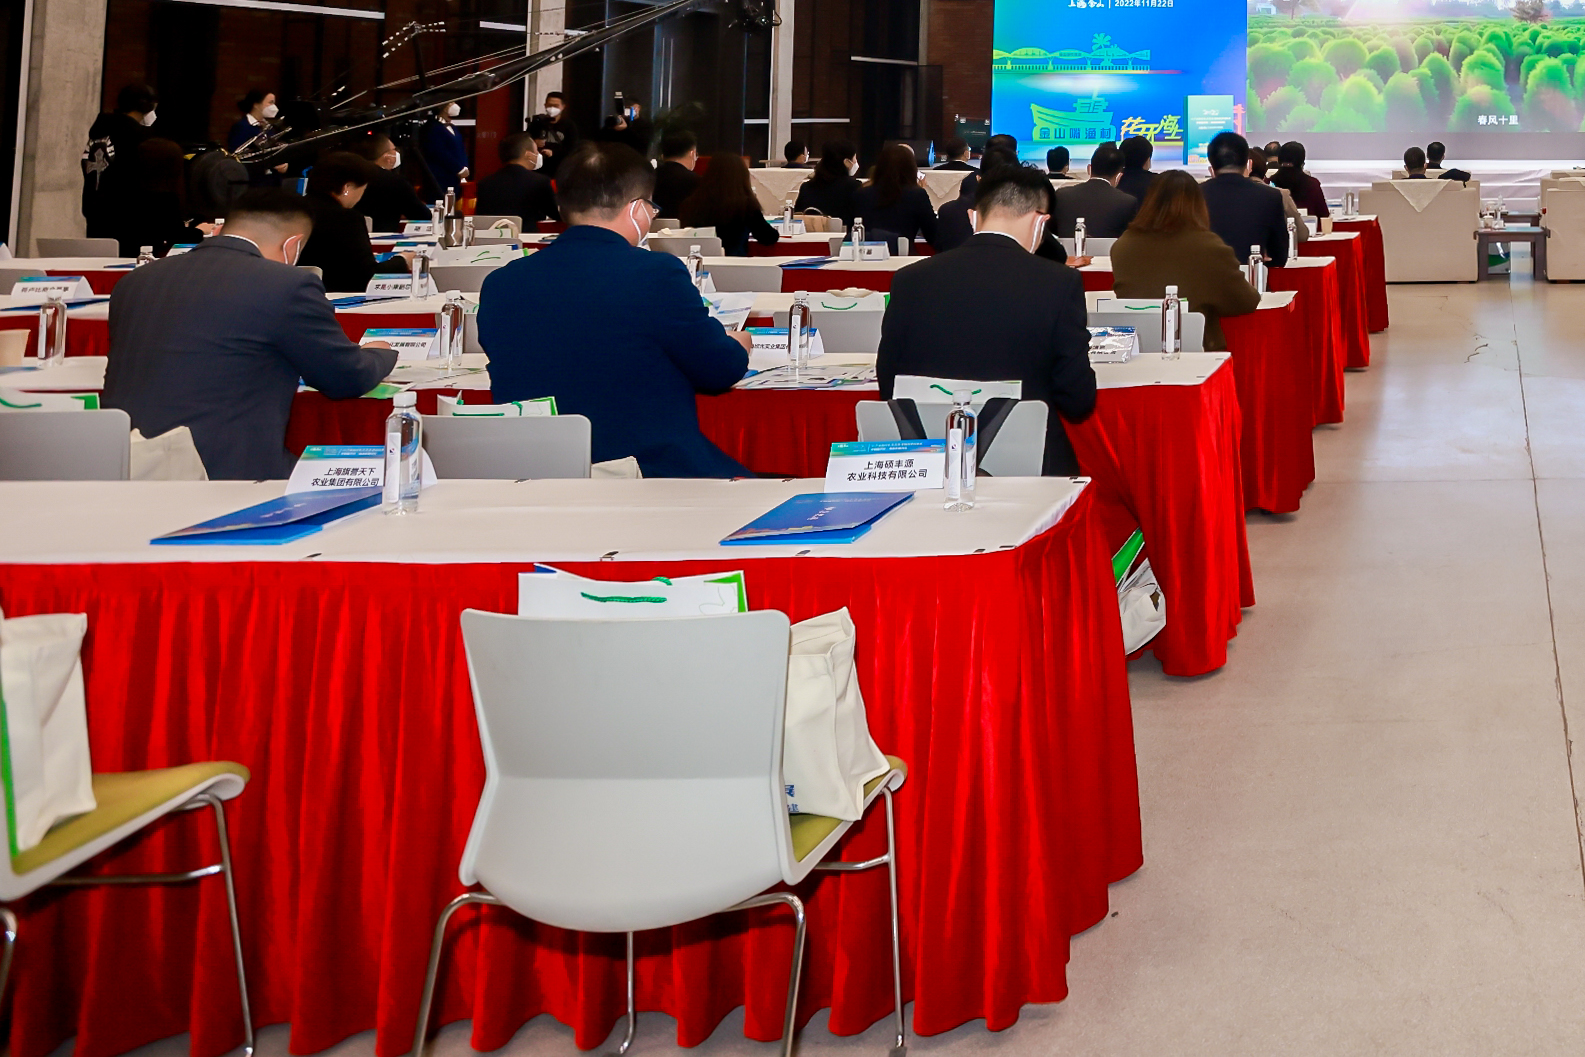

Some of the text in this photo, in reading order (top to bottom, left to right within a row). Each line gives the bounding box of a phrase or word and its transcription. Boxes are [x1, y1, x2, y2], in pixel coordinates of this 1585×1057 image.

[1114, 0, 1174, 7] 2022年11月22日
[1477, 114, 1519, 126] 春风十里
[1039, 127, 1112, 140] 金山嘴渔村
[864, 458, 915, 471] 上海硕丰源
[846, 468, 928, 482] 农业科技有限公司
[311, 477, 380, 487] 农业集团有限公司
